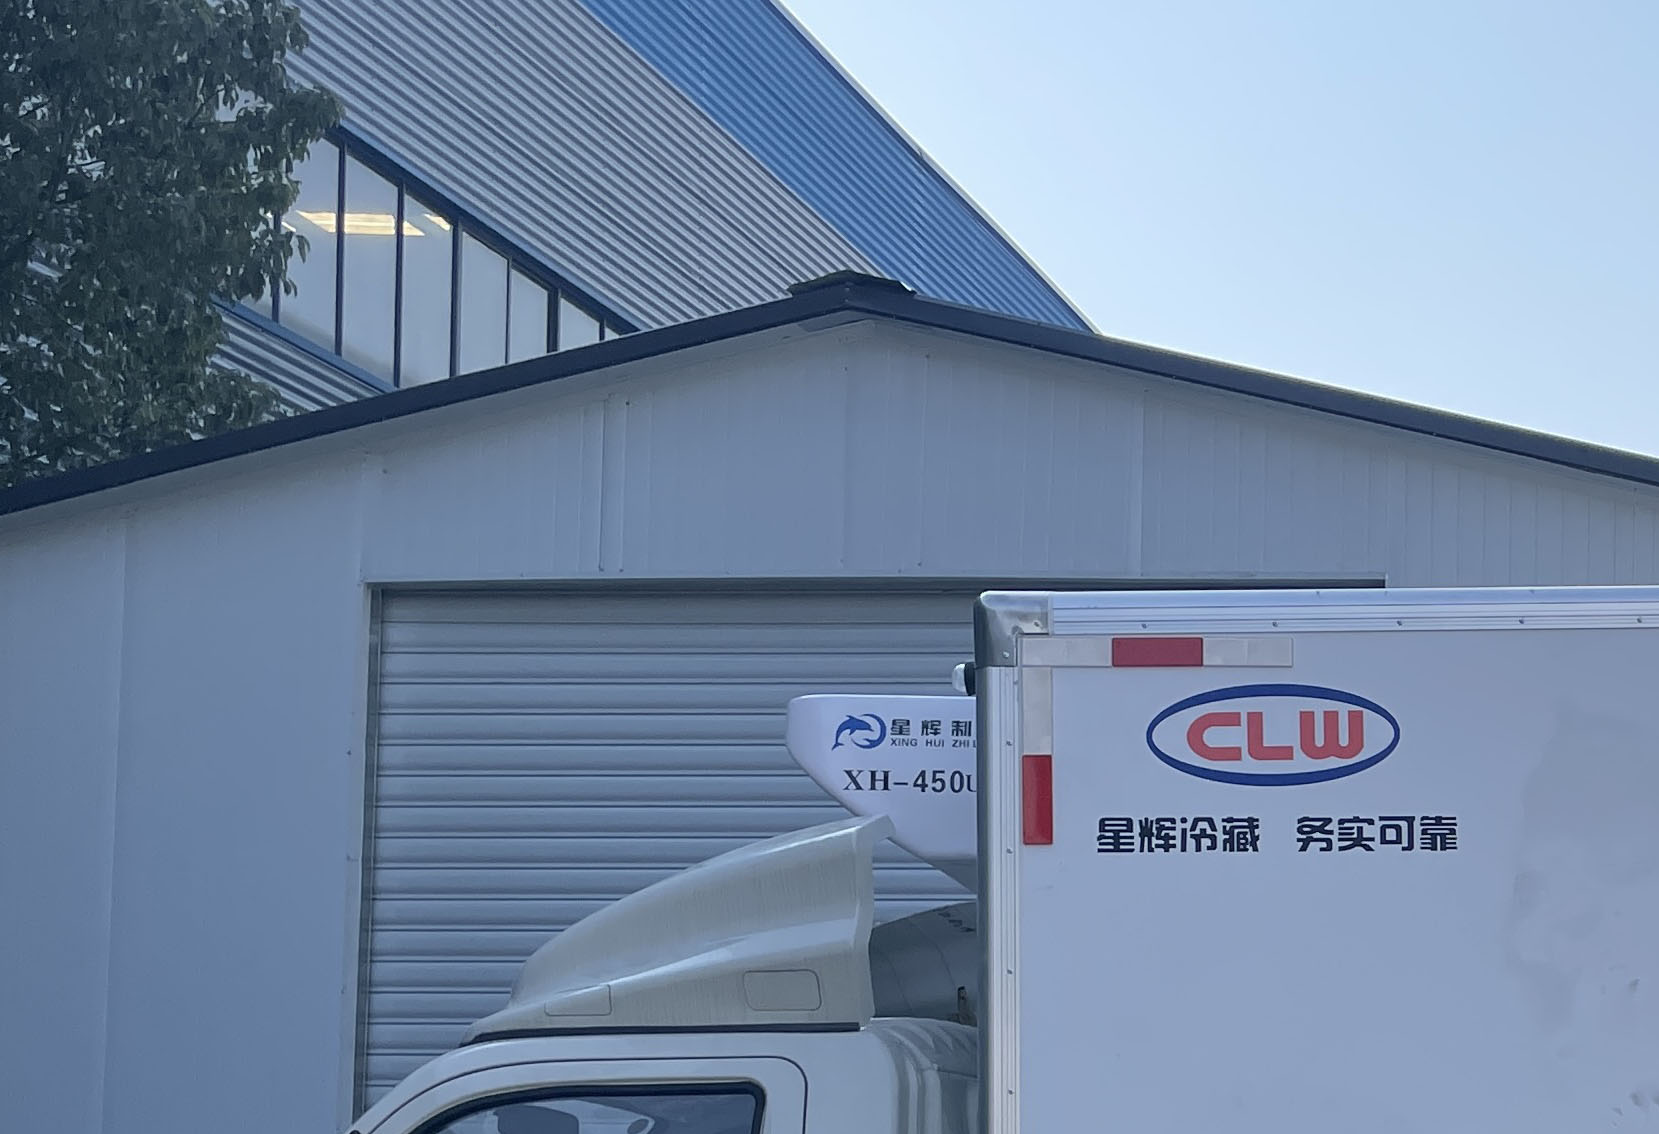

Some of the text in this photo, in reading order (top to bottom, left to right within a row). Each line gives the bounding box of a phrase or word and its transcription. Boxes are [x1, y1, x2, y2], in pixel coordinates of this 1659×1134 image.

[890, 738, 918, 747] XING
[925, 738, 945, 748] HUI
[951, 739, 970, 749] ZHI
[1187, 710, 1365, 762] CLW
[1097, 815, 1458, 853] 星辉冷藏 务实可靠
